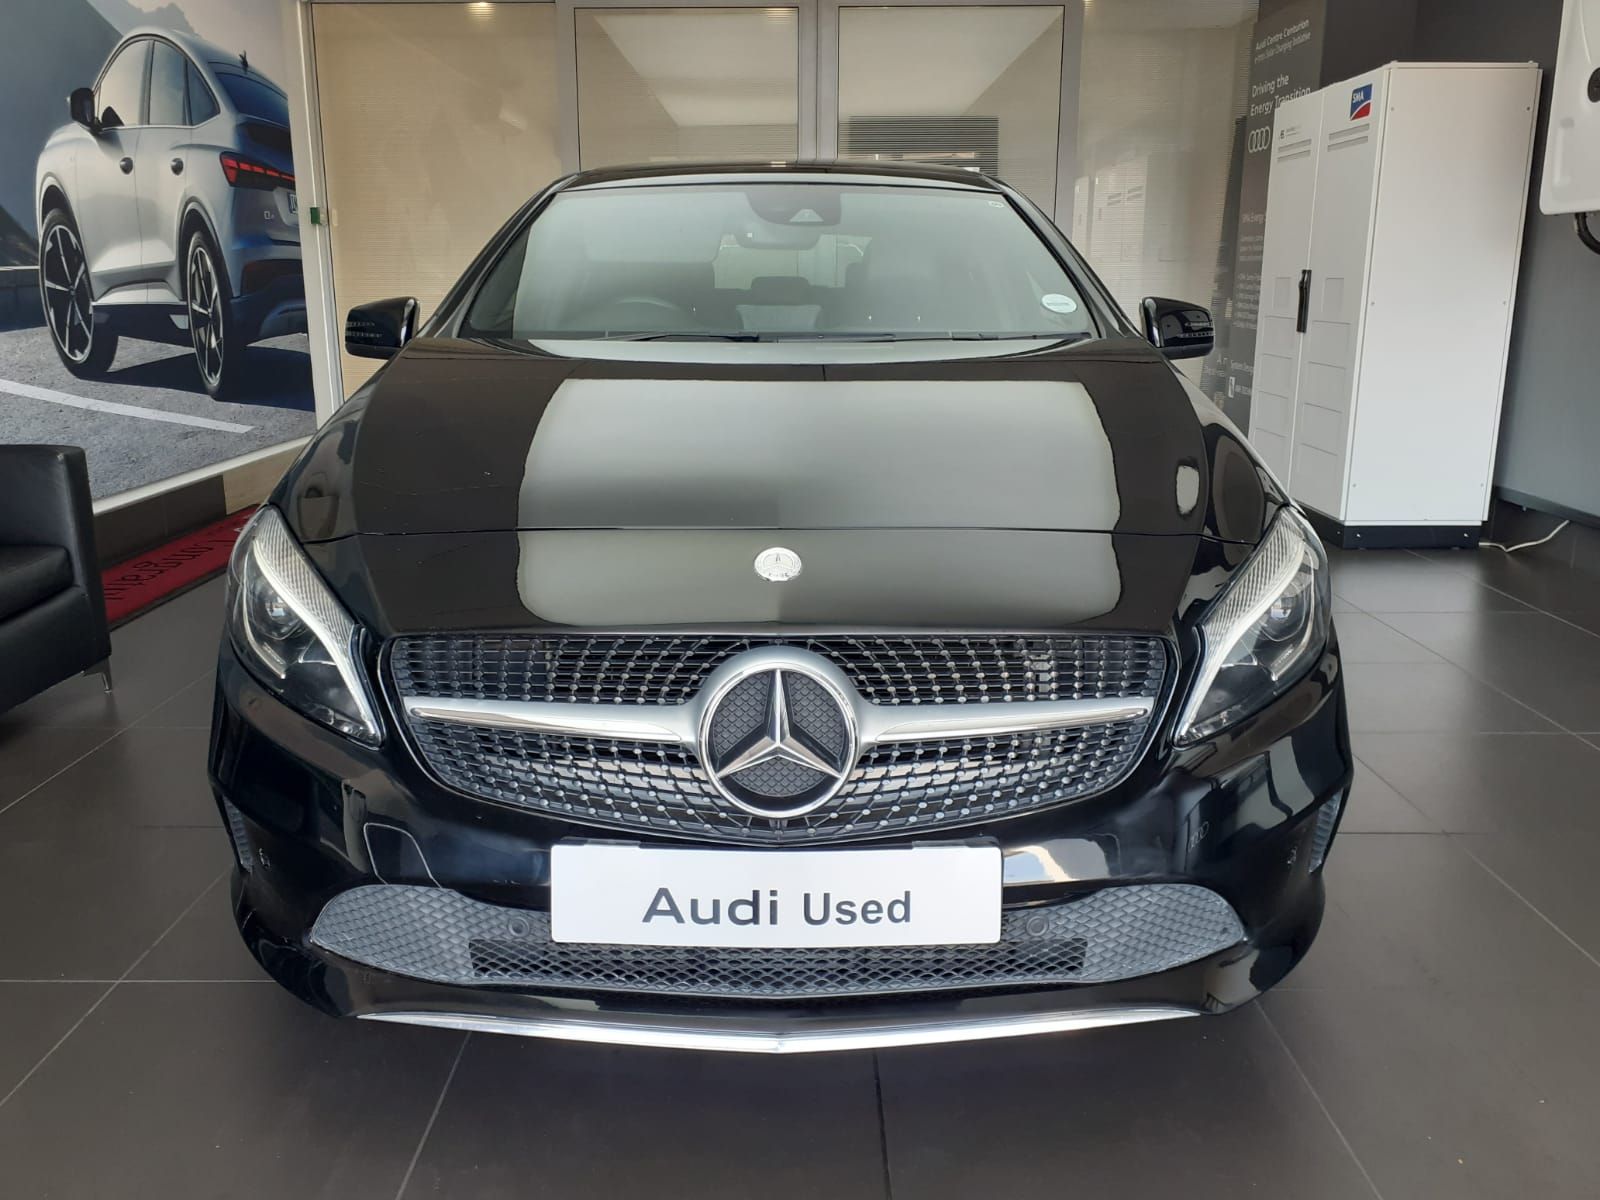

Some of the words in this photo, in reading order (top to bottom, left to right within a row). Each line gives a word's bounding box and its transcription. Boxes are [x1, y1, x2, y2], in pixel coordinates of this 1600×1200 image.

[1252, 80, 1275, 98] Driving
[1277, 74, 1289, 88] the
[1250, 100, 1274, 117] Energy
[642, 887, 778, 926] Audi
[803, 890, 911, 926] Used
